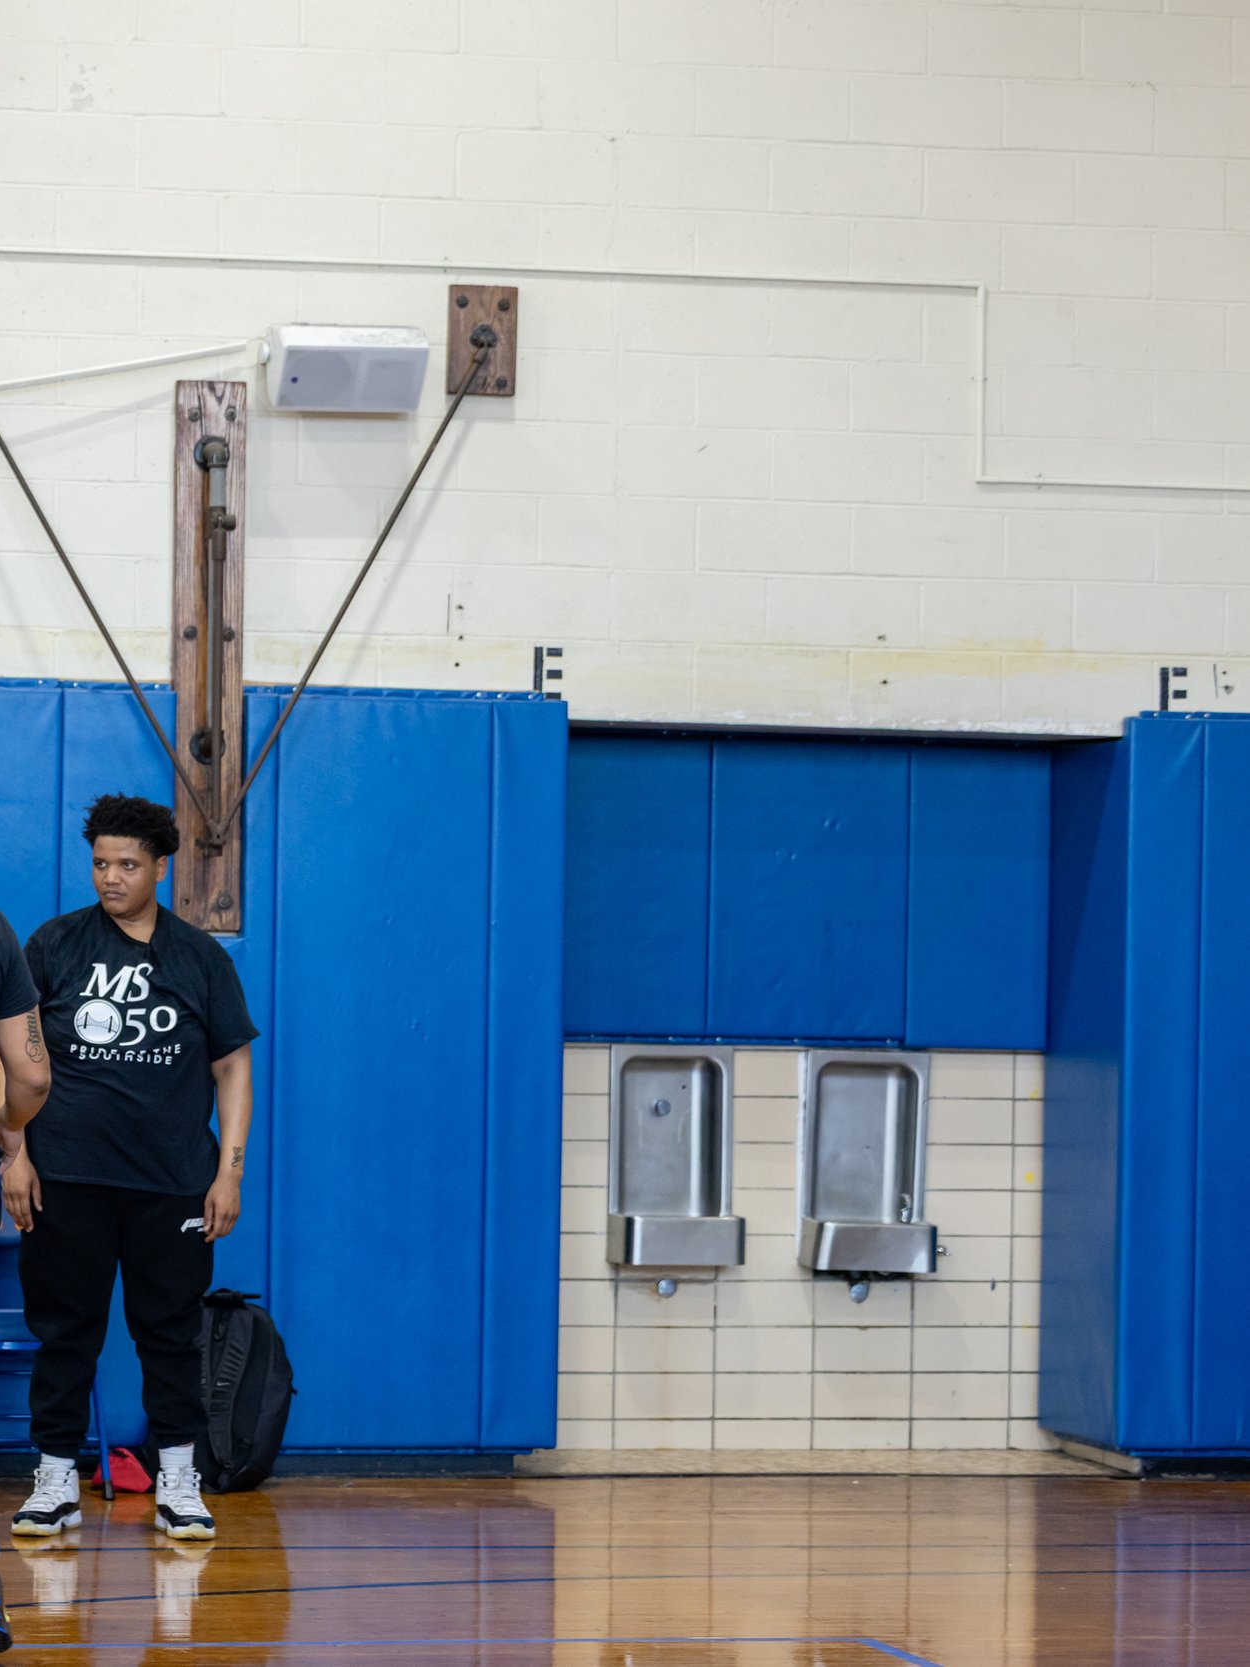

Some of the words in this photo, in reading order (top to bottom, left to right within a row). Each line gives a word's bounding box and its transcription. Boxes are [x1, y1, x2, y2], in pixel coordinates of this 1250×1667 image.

[533, 646, 562, 700] E
[79, 963, 154, 1004] MS
[119, 1006, 178, 1046] 50
